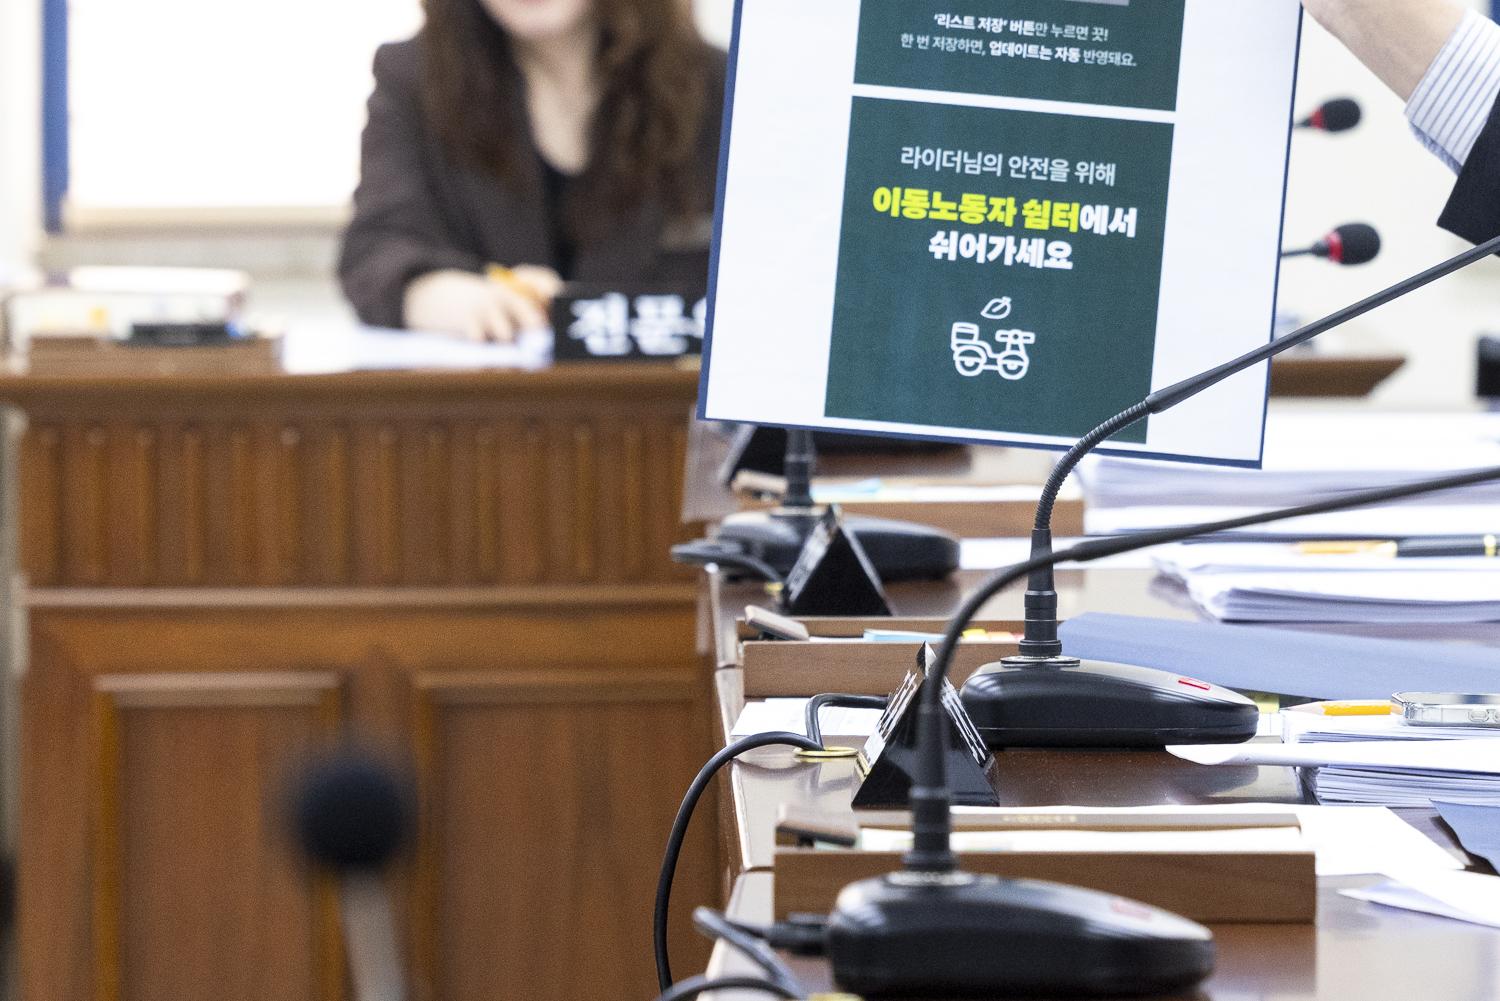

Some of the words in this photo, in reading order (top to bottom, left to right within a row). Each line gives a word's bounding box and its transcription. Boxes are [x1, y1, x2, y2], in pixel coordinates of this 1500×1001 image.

[900, 33, 914, 49] 한
[916, 35, 930, 50] 번
[931, 36, 986, 56] 저장하면,
[989, 41, 1053, 60] 업데이트는
[1054, 46, 1081, 63] 자동
[1009, 19, 1048, 38] 버튼만
[1050, 23, 1089, 41] 누르면
[900, 145, 1003, 177] 라이더님의
[1008, 155, 1070, 183] 안전을
[1074, 160, 1116, 187] 위해
[872, 186, 1017, 228] 이동노동자
[1022, 198, 1138, 238] 쉼터에서
[928, 230, 1073, 270] 쉬어가세요
